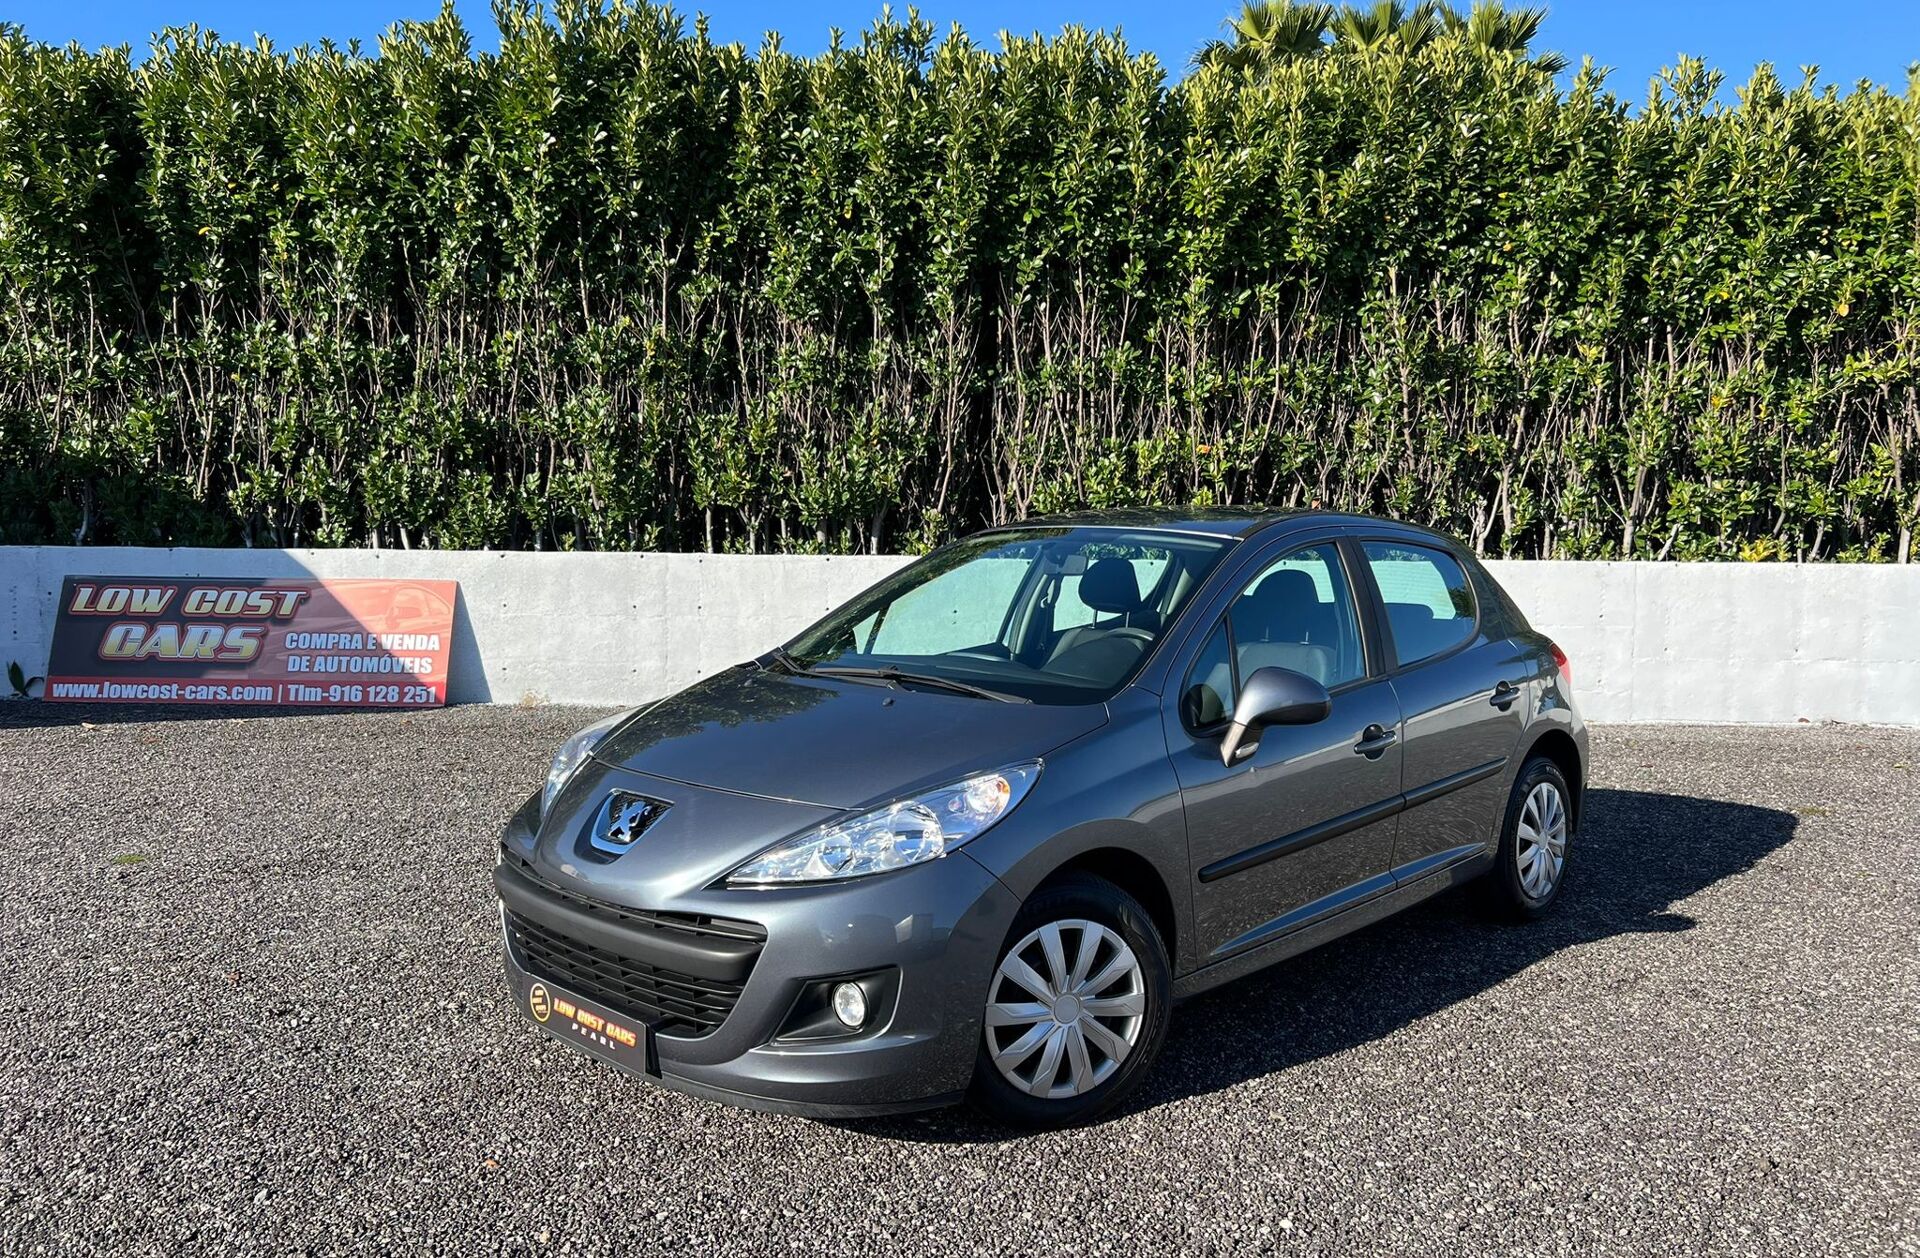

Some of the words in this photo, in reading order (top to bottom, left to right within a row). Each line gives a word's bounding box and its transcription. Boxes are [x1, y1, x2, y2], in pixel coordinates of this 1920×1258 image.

[70, 586, 176, 614] LOW
[182, 588, 309, 616] COST
[101, 623, 267, 659] CARS
[285, 632, 363, 650] COMPRA
[366, 633, 378, 650] E
[380, 633, 441, 651] VENDA
[287, 655, 310, 673] DE
[313, 653, 433, 674] AUTOMÓVEIS
[52, 681, 274, 701] www.lowcost-cars.com
[287, 684, 363, 703] Tlm-916
[366, 685, 400, 703] 128
[403, 686, 436, 703] 251
[553, 997, 576, 1019] LOW
[576, 1008, 605, 1032] COST
[605, 1022, 637, 1048] CARS
[571, 1022, 616, 1050] PEARL
